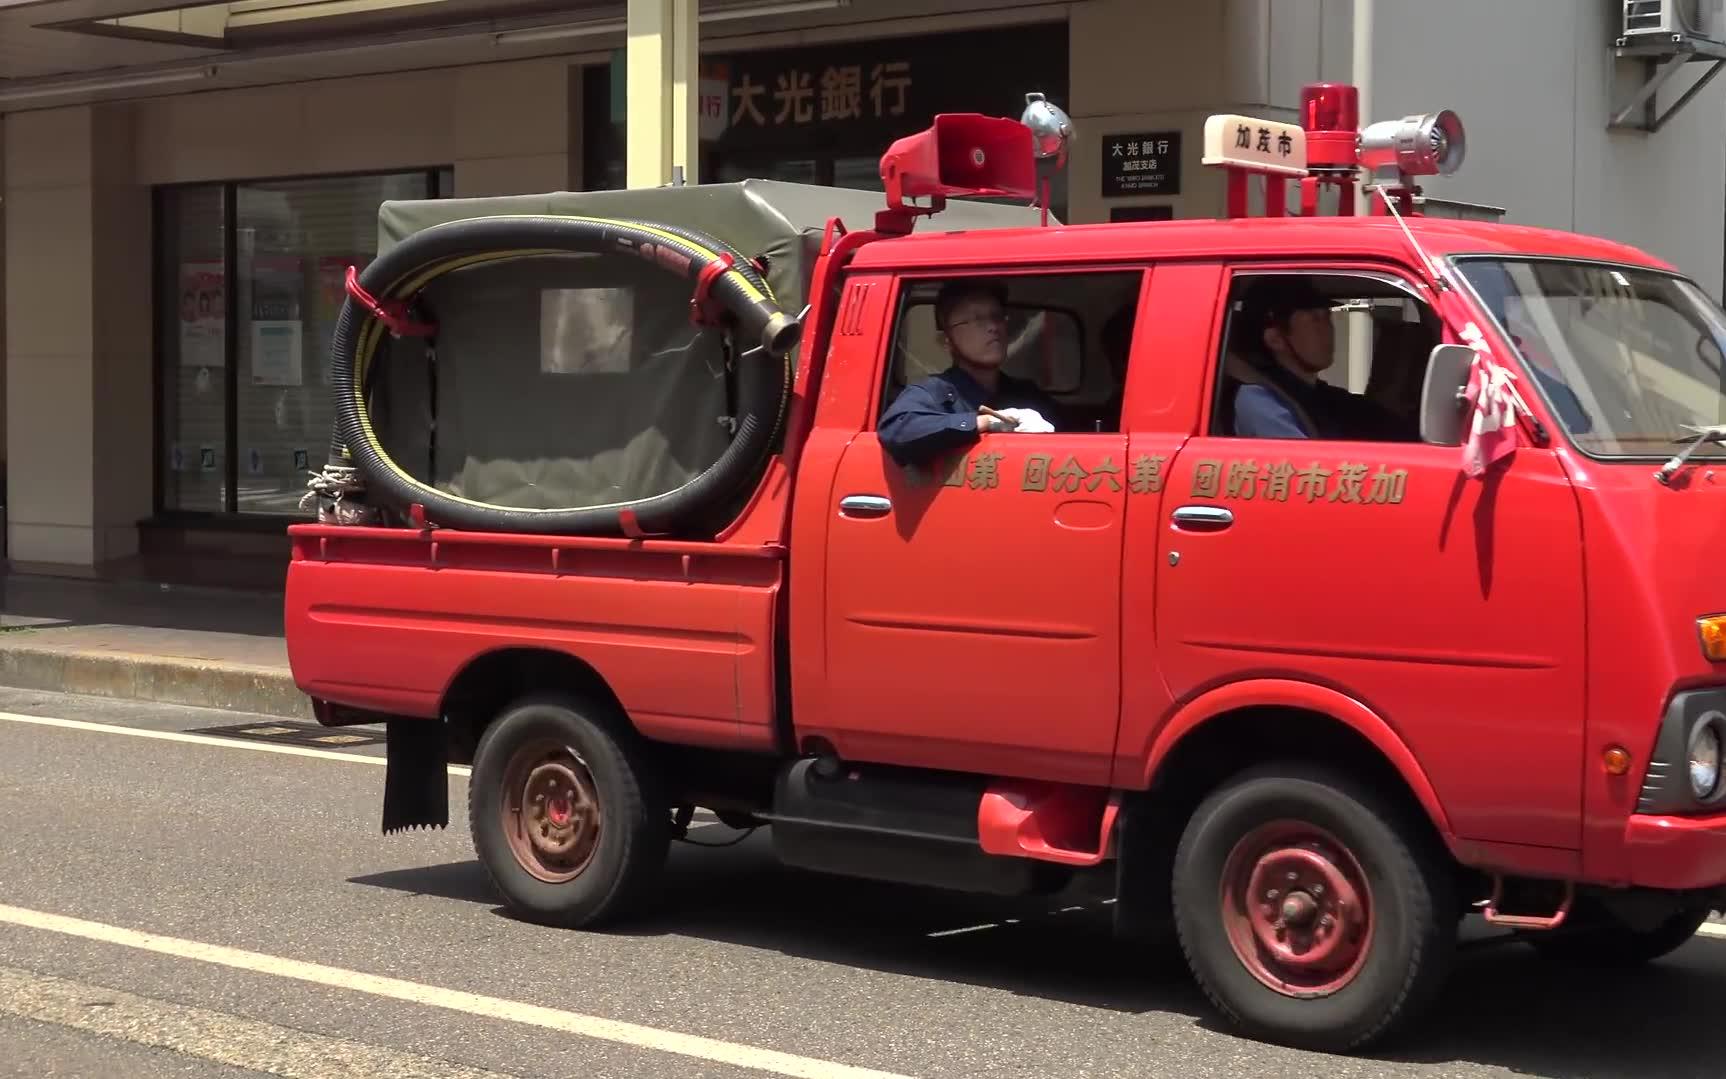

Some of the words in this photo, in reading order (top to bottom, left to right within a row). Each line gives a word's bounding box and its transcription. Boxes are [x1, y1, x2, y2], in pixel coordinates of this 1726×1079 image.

[731, 61, 912, 126] 大光銀行
[1112, 140, 1169, 156] 大光銀行
[1235, 123, 1293, 158] 加茂市
[1122, 159, 1158, 172] 加茂支店
